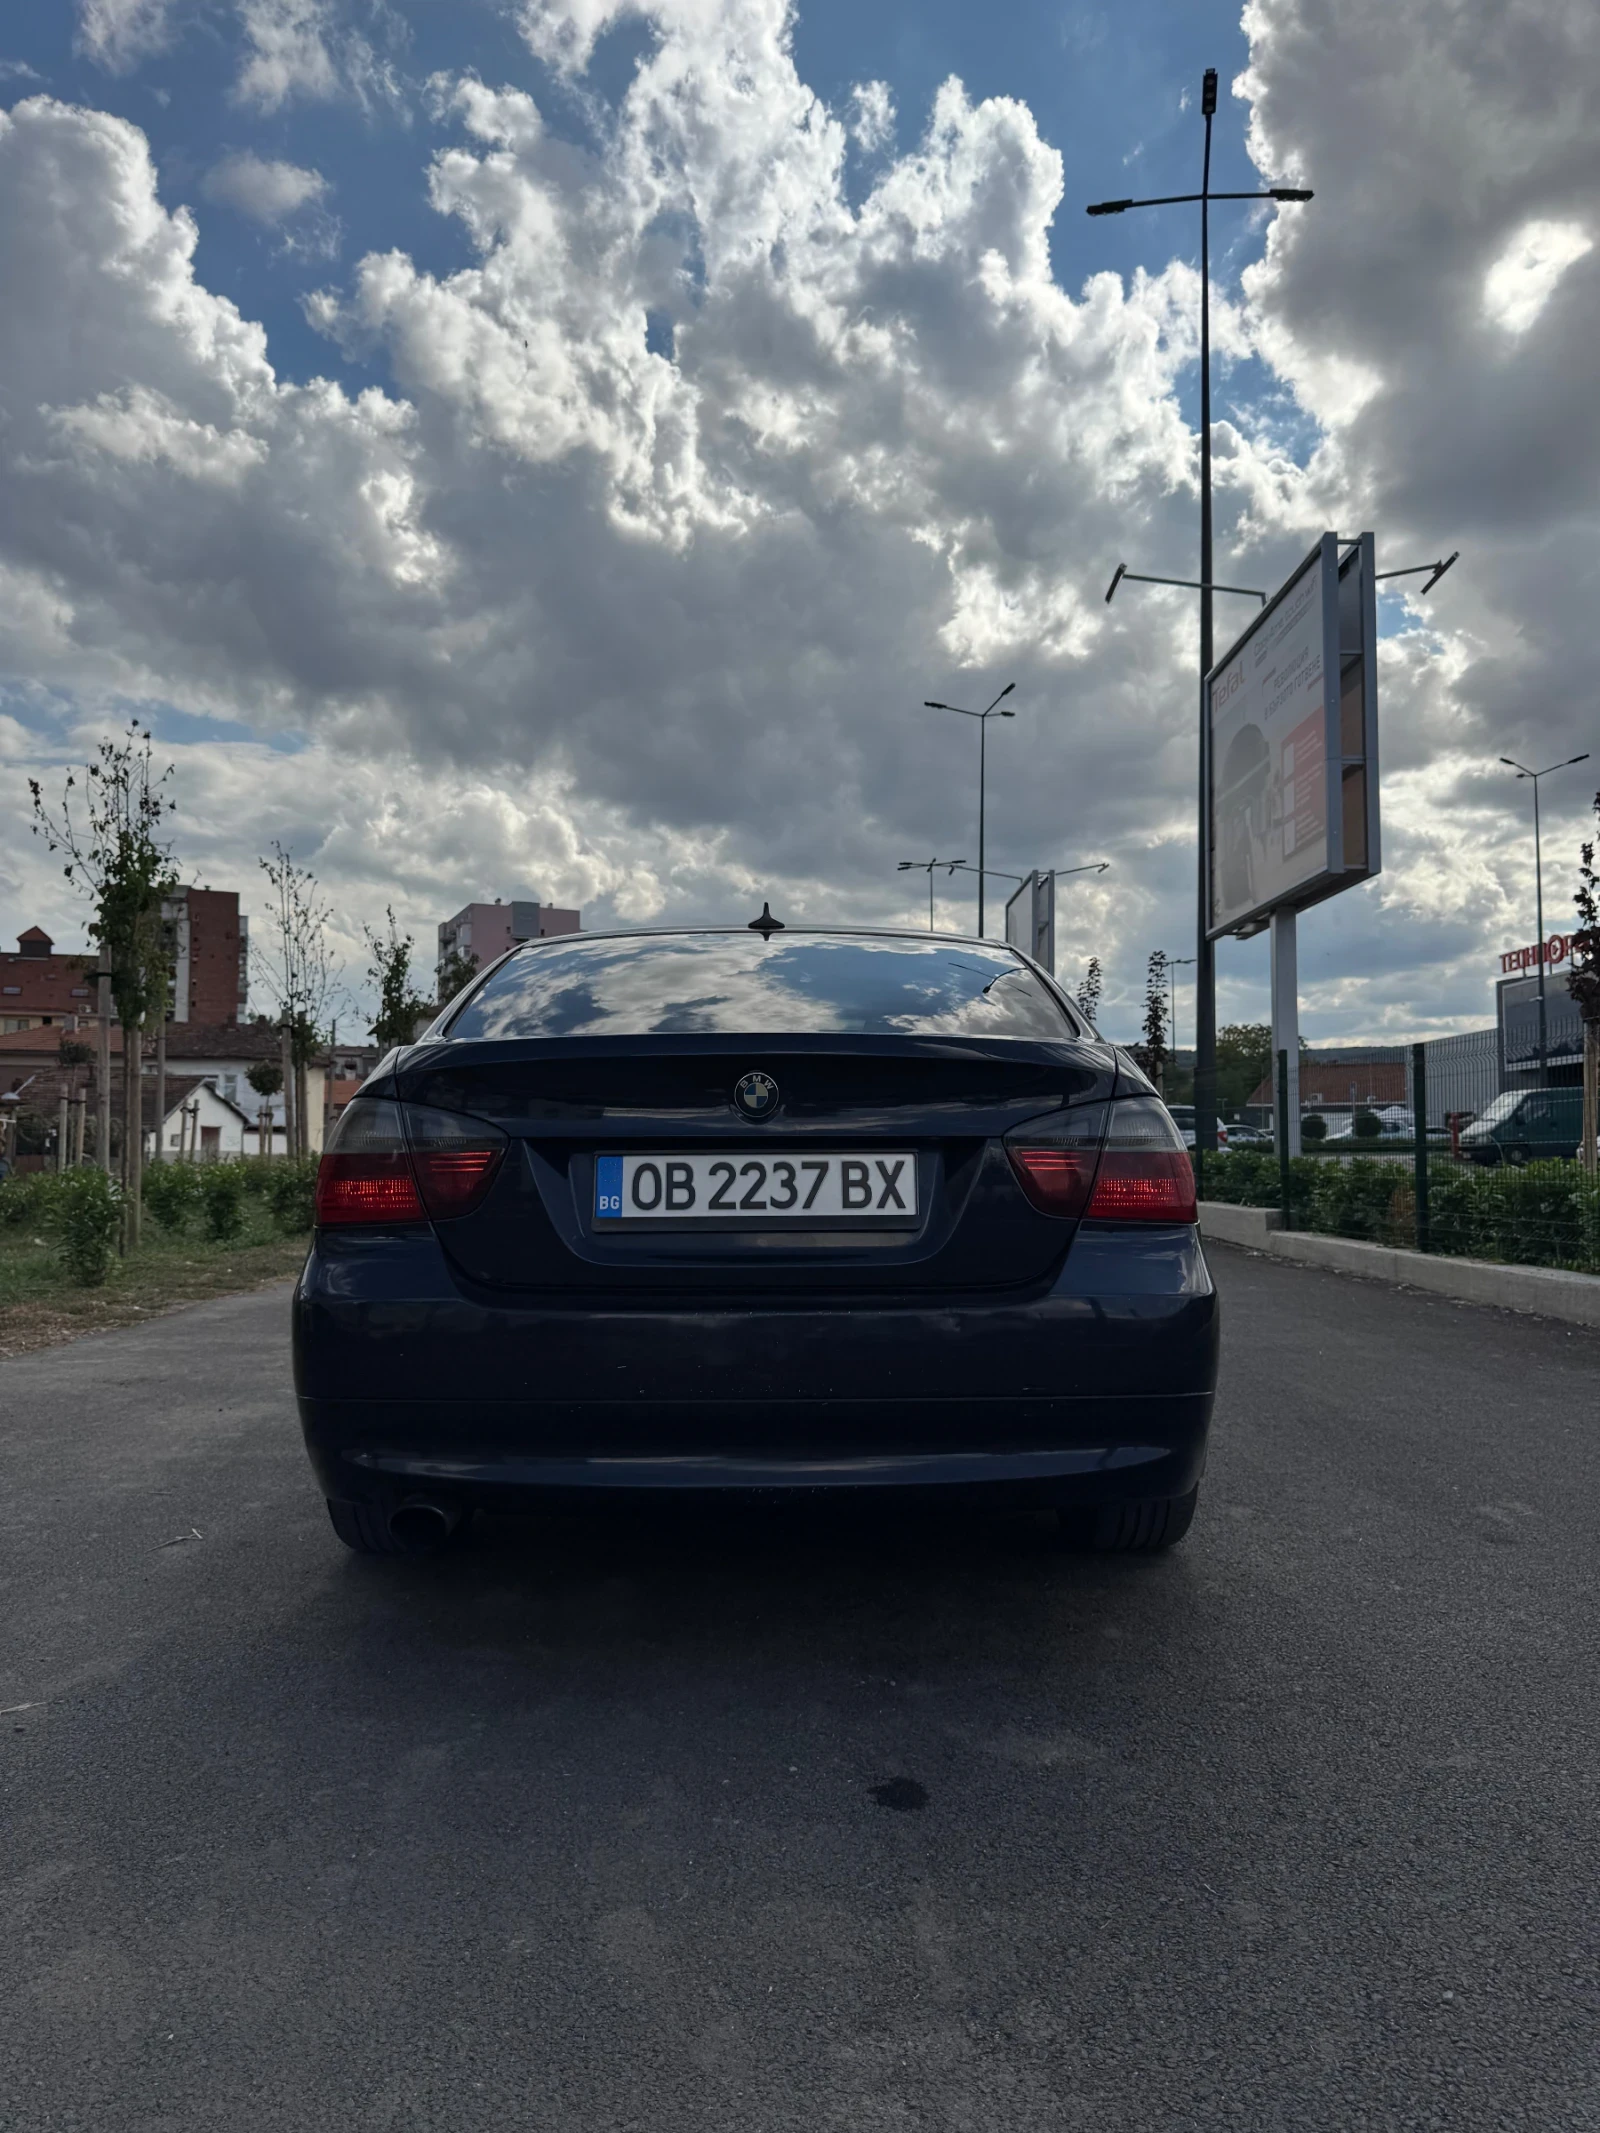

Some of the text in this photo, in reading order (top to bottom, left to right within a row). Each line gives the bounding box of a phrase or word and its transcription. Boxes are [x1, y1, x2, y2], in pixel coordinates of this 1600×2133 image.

[1212, 659, 1246, 713] Tefal
[739, 1074, 775, 1090] BMW
[631, 1160, 907, 1211] OB 2237 BX
[599, 1196, 620, 1211] BG
